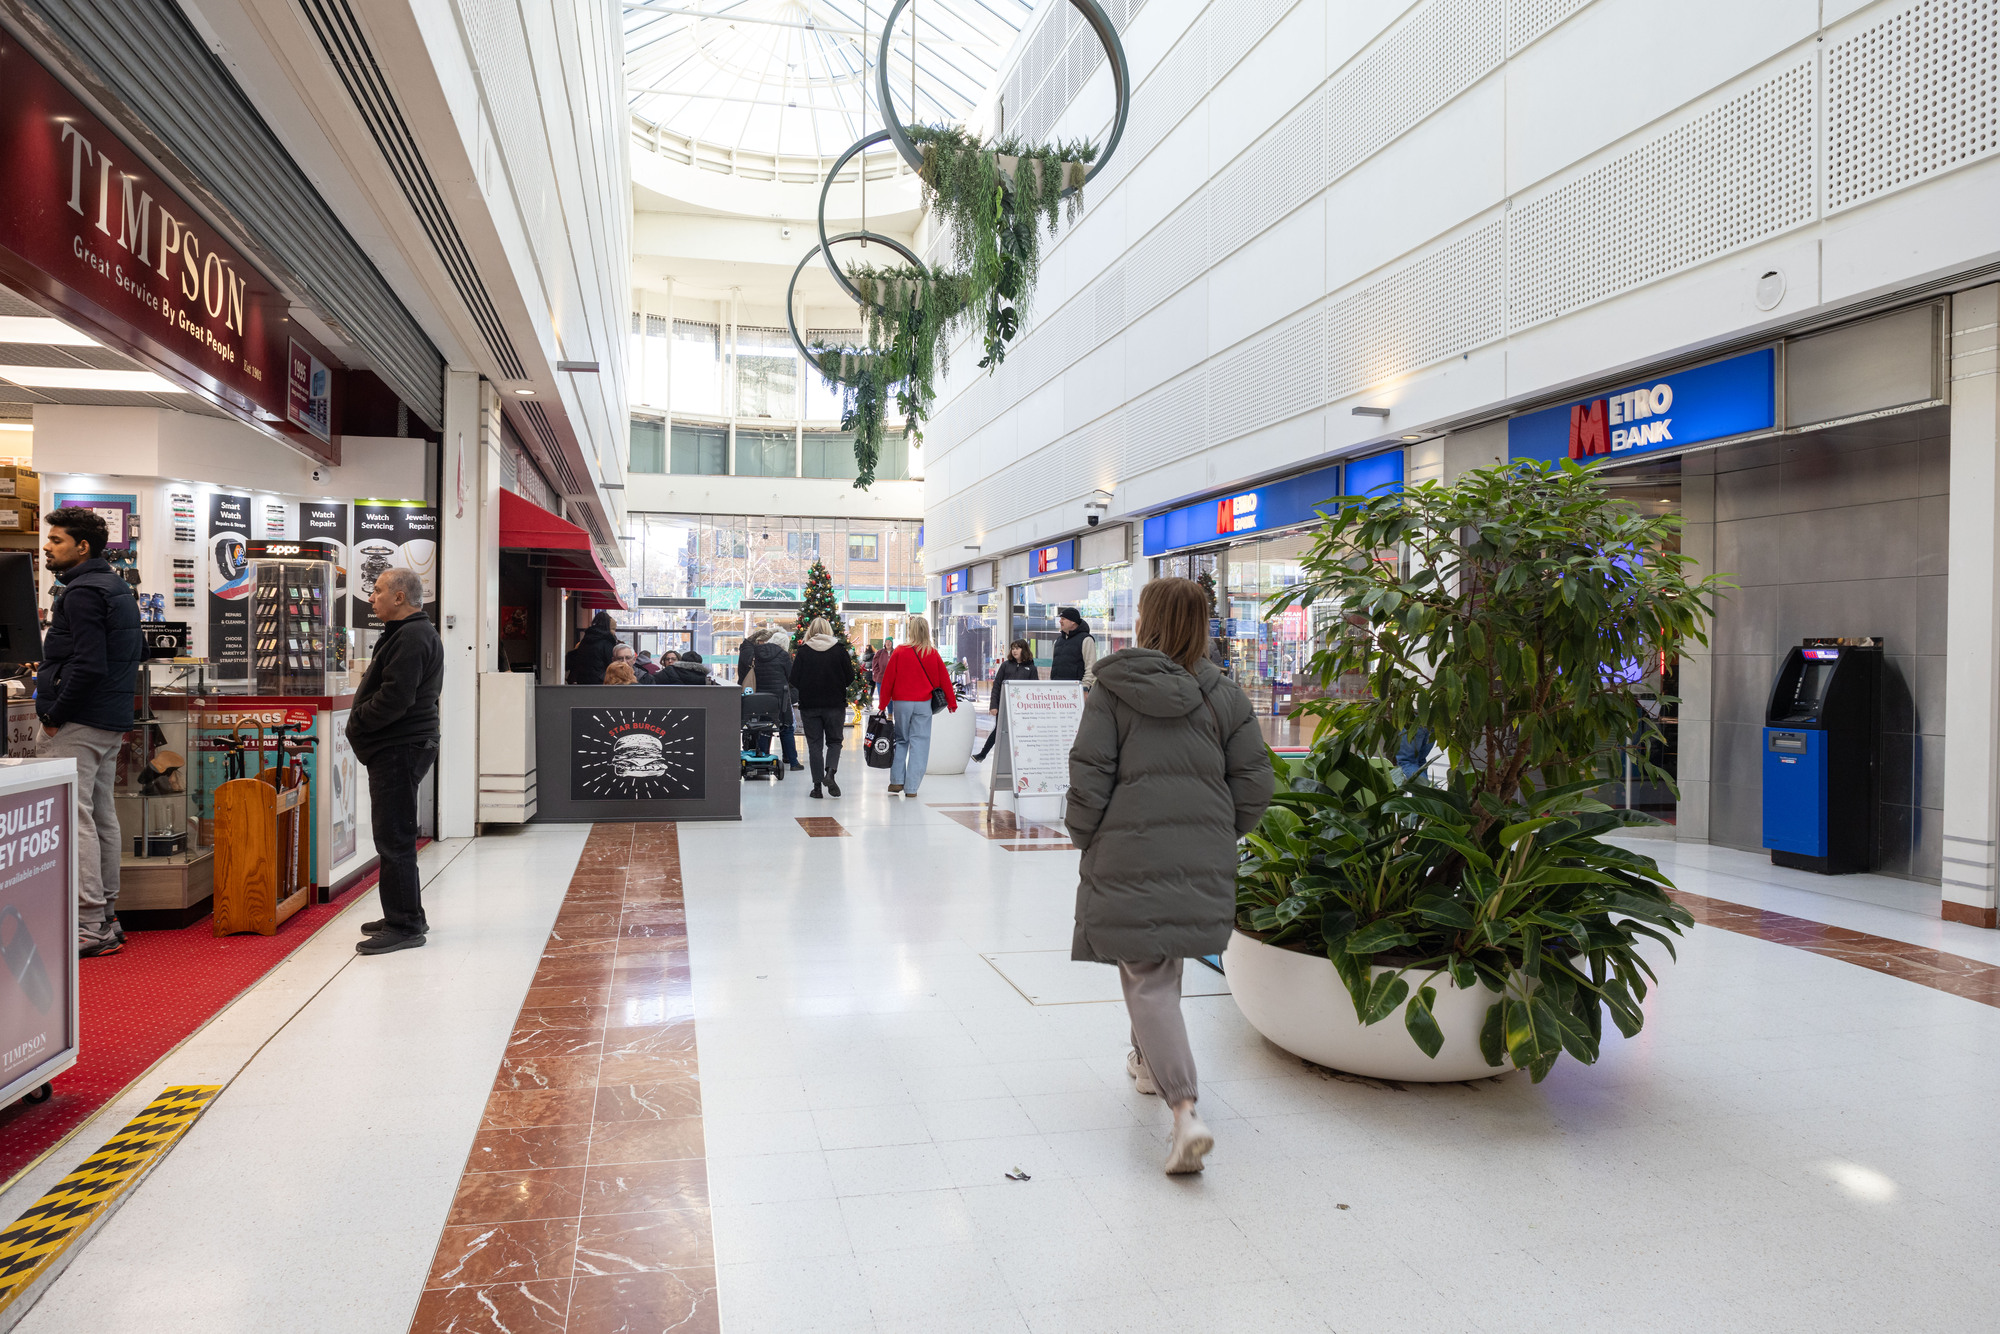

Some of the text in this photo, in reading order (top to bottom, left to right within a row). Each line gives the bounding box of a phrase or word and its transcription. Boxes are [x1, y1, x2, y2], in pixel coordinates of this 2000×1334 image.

[61, 121, 247, 337] TIMPSON
[73, 235, 235, 363] Great Service By Great People
[243, 359, 252, 375] Est
[1568, 384, 1673, 460] METRO
[1611, 419, 1673, 452] BANK
[221, 501, 240, 510] Smart
[220, 511, 241, 520] Watch
[311, 511, 335, 519] Watch
[405, 514, 437, 522] Jewellery
[310, 520, 336, 528] Repairs
[361, 522, 394, 531] Servicing
[408, 522, 434, 530] Repairs
[266, 544, 300, 555] zippo
[1017, 702, 1051, 710] Opening
[242, 712, 282, 724] TAGS
[14, 728, 18, 743] 3
[28, 726, 33, 741] 2
[608, 723, 666, 736] STAR BURGER
[8, 748, 20, 758] Key
[20, 825, 60, 862] FOBS
[4, 868, 32, 888] available
[33, 860, 56, 875] in-store
[3, 1032, 47, 1066] TIMPSON
